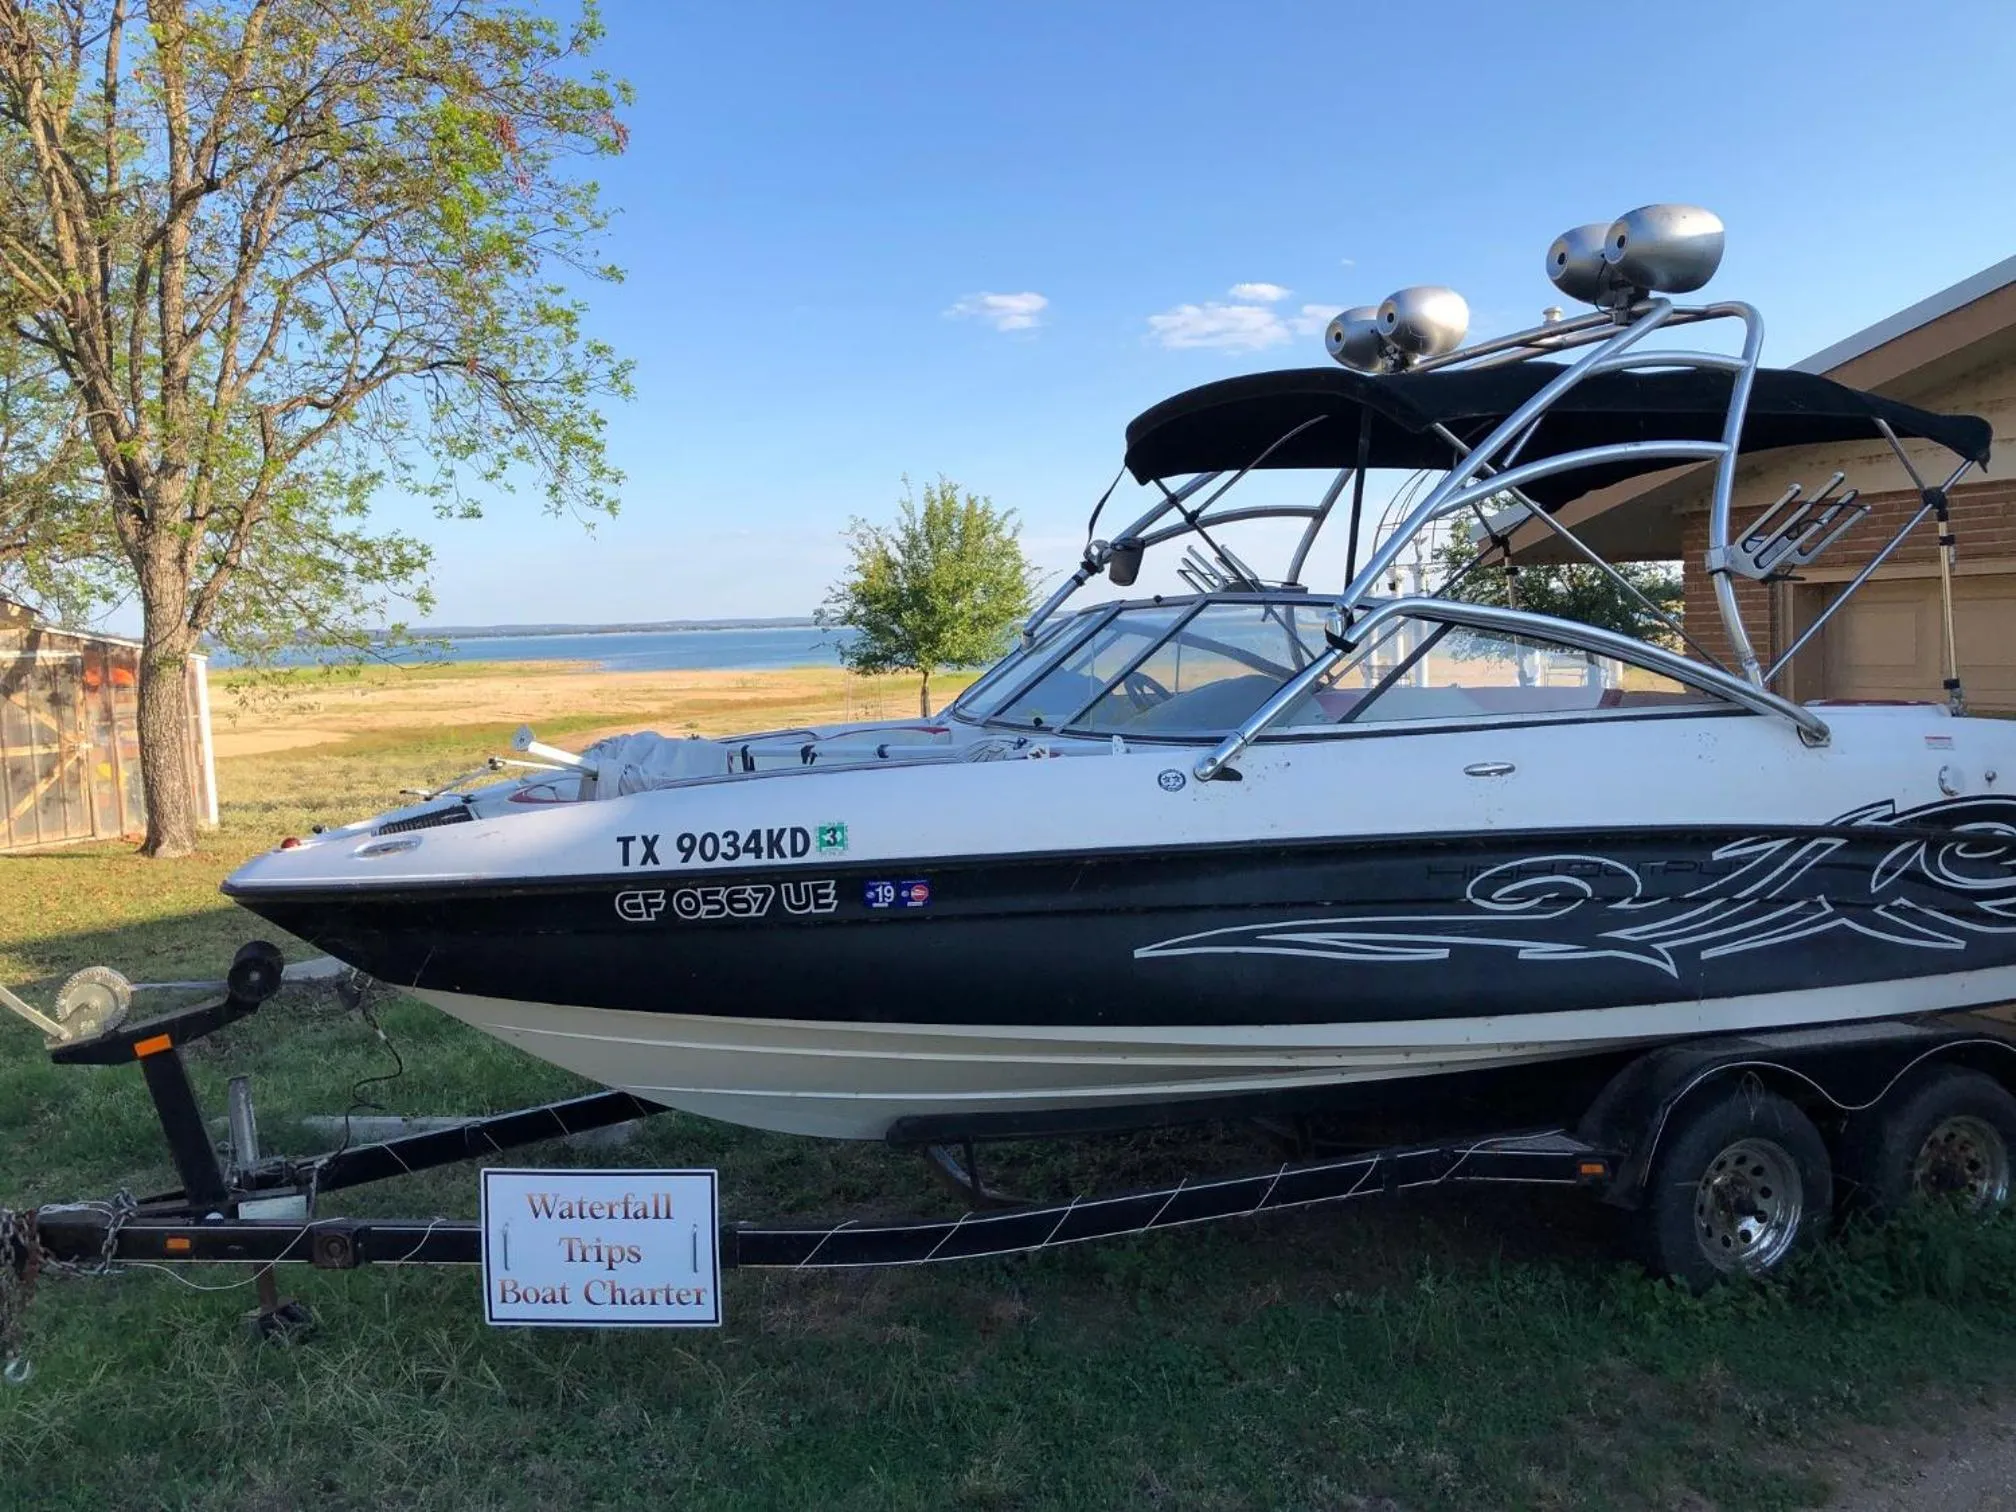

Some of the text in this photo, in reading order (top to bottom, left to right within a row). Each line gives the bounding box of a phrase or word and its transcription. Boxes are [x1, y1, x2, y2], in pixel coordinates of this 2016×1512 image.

[616, 826, 811, 867] TX 9034KD
[826, 826, 838, 847] 3
[615, 880, 837, 921] CF 0567 UE
[875, 885, 895, 903] 19
[525, 1192, 675, 1220] Waterfall
[558, 1236, 642, 1271] Trips
[498, 1278, 708, 1306] Boat Charter
